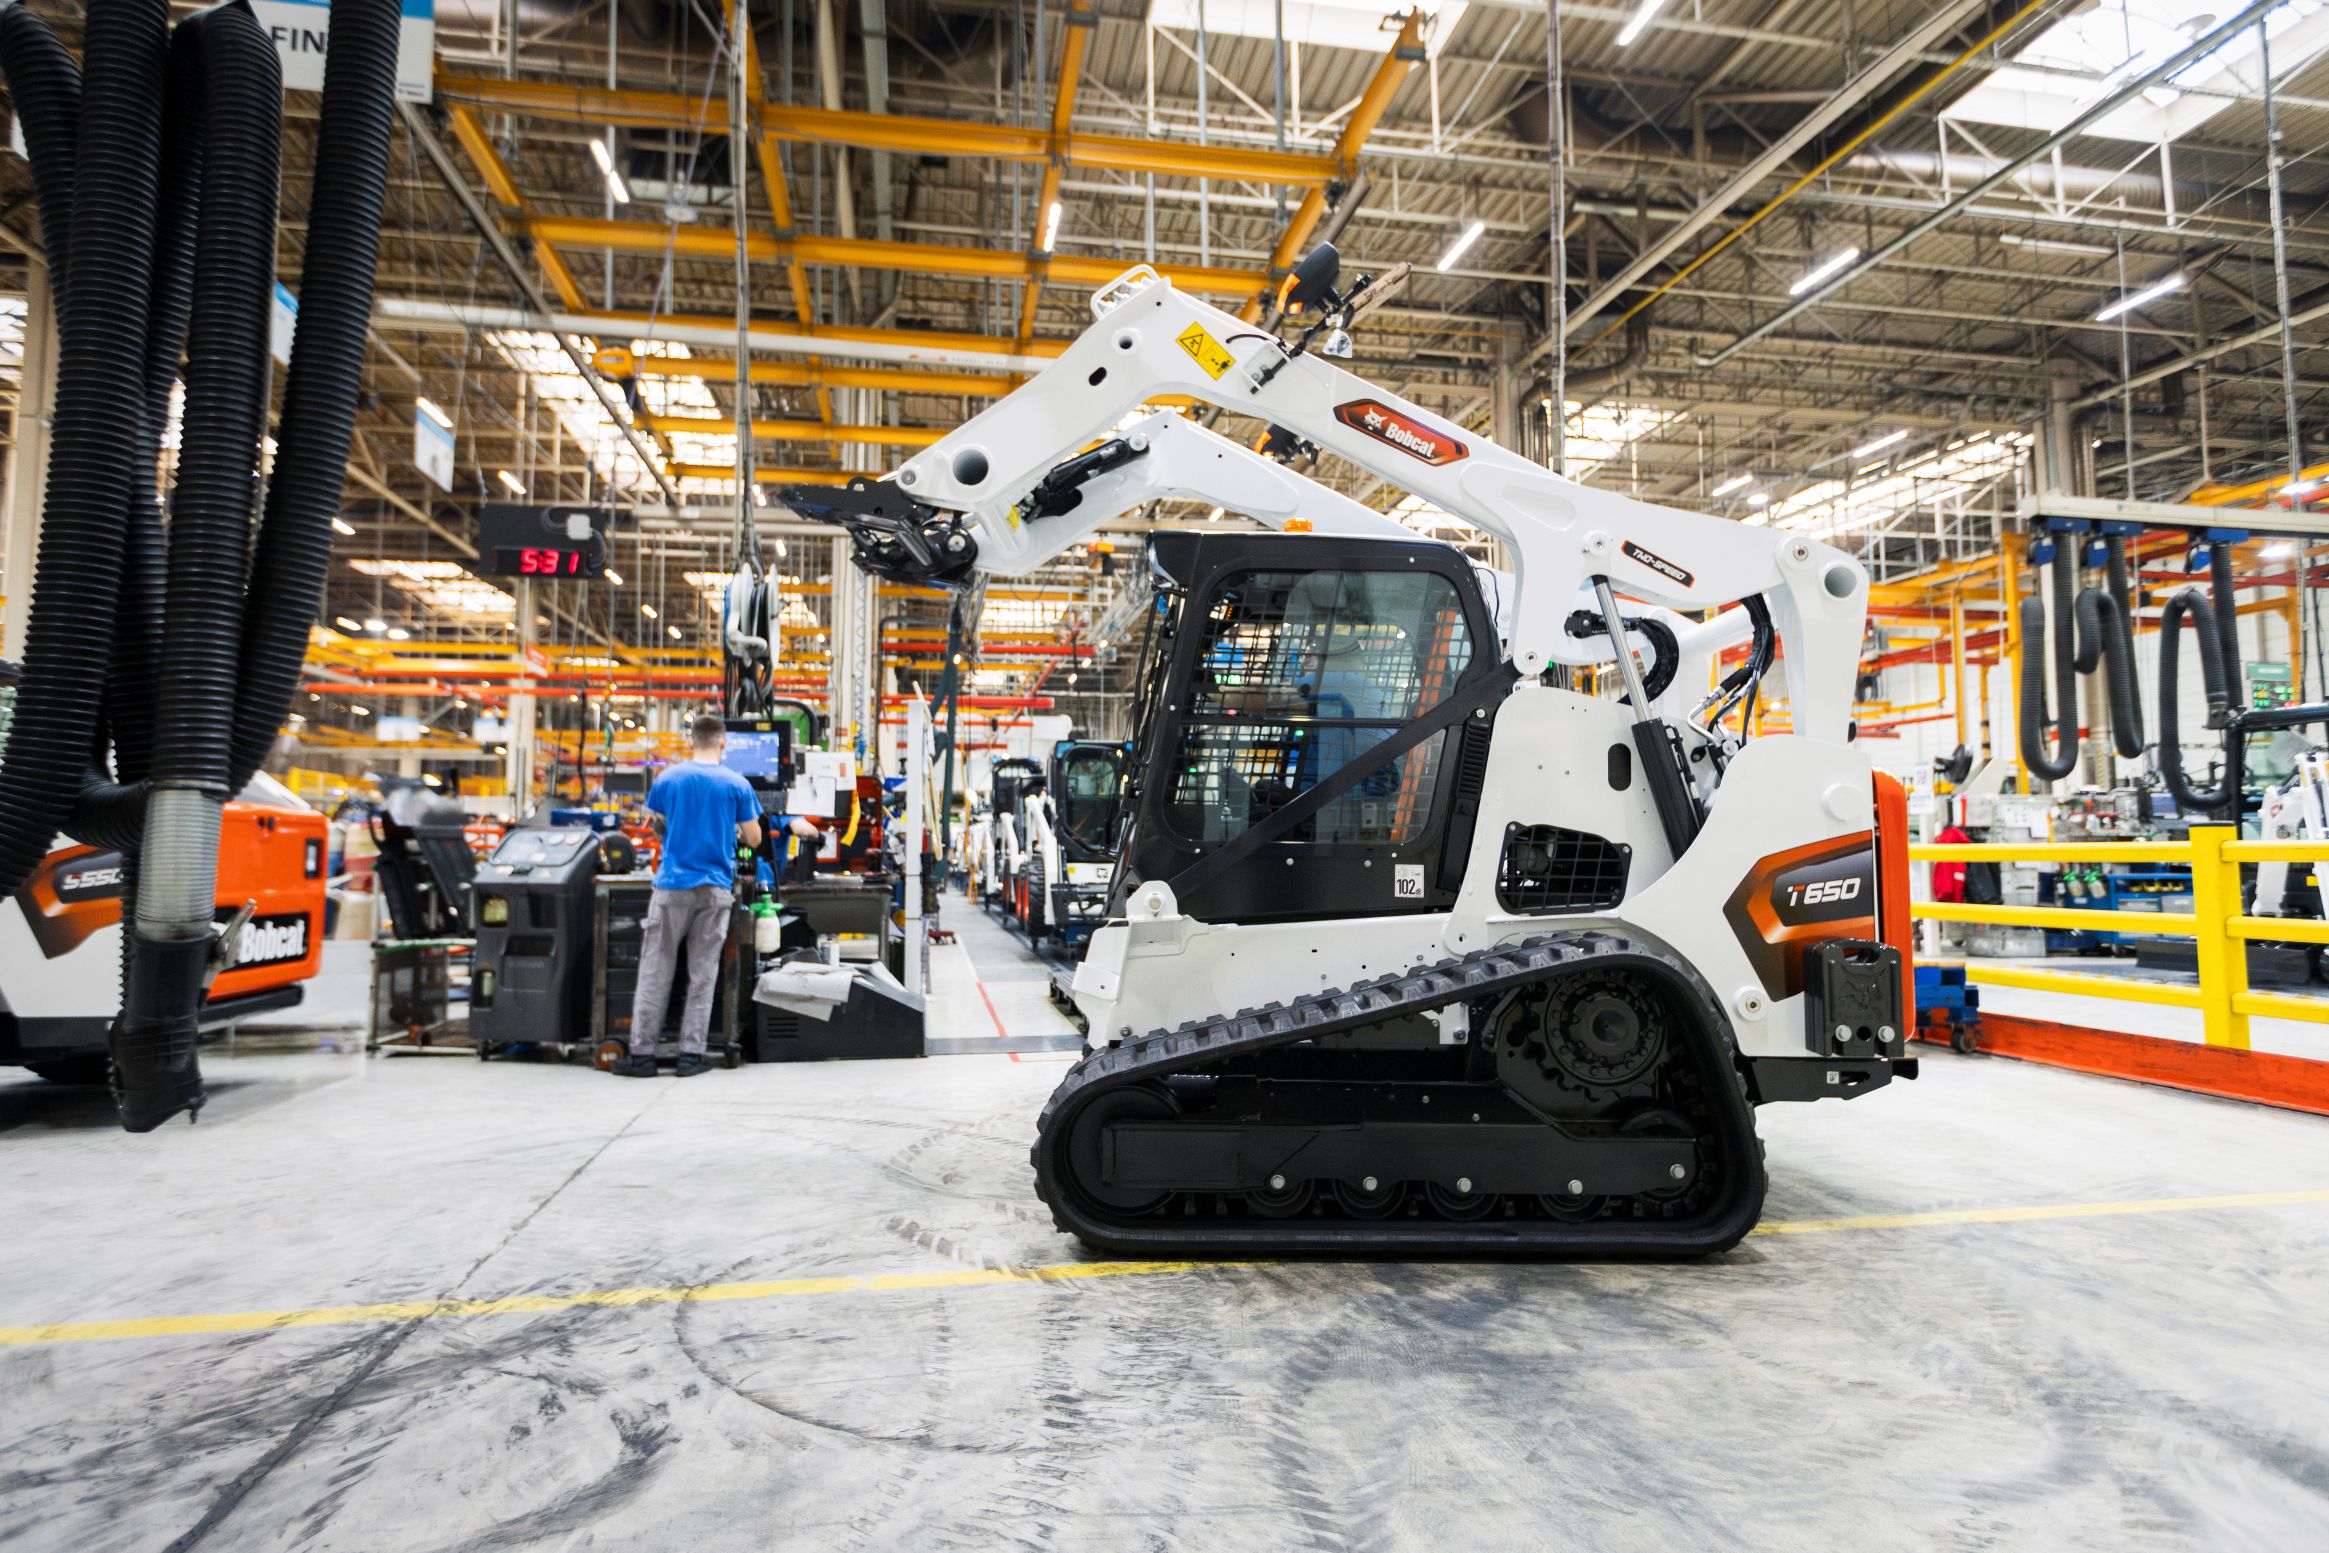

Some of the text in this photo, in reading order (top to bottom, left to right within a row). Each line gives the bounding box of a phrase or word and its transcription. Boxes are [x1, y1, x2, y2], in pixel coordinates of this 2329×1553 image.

[271, 26, 326, 54] FIN
[1385, 422, 1437, 458] Bobcat
[1632, 548, 1687, 581] TWO-SPEED
[1396, 878, 1416, 895] 102
[1787, 877, 1861, 907] T650
[239, 919, 305, 963] Bobcat
